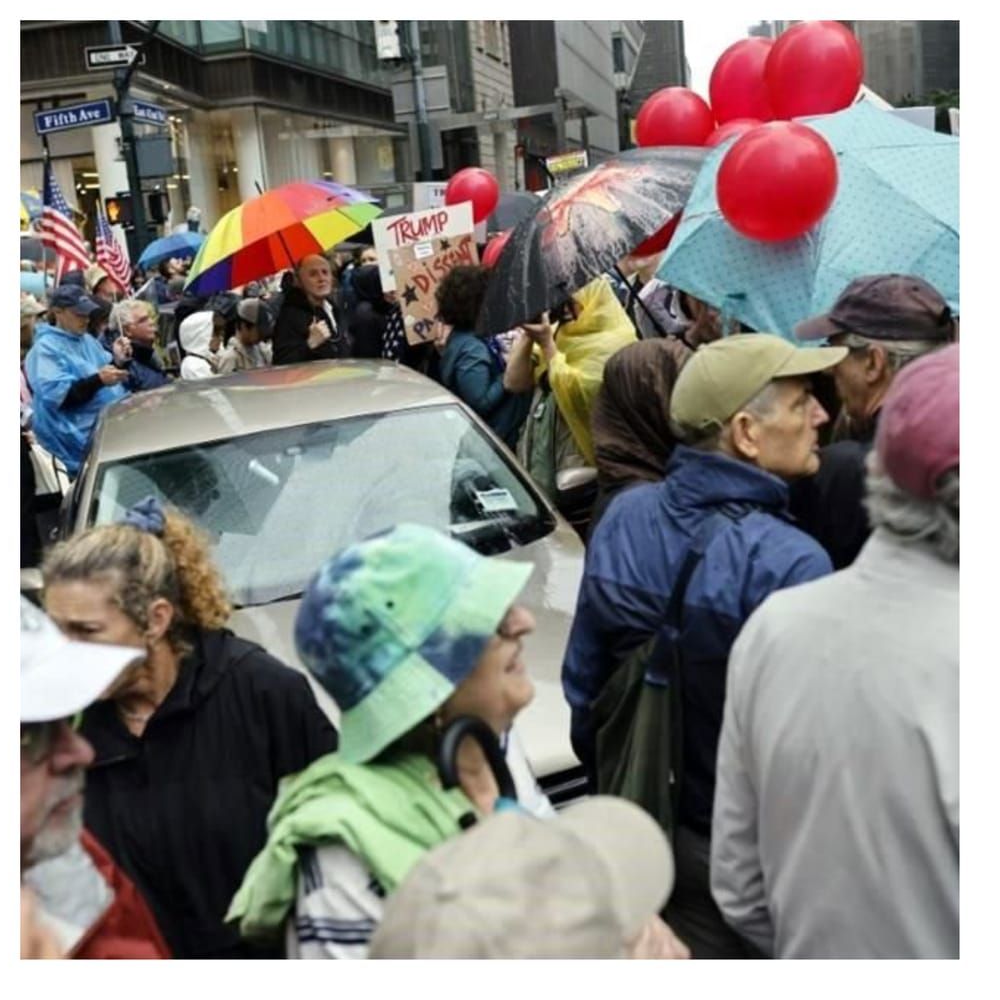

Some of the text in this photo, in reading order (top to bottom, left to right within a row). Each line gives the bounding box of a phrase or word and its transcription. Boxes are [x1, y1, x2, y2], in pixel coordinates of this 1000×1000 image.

[43, 108, 101, 128] Fifth Ave
[386, 210, 450, 247] TRUMP
